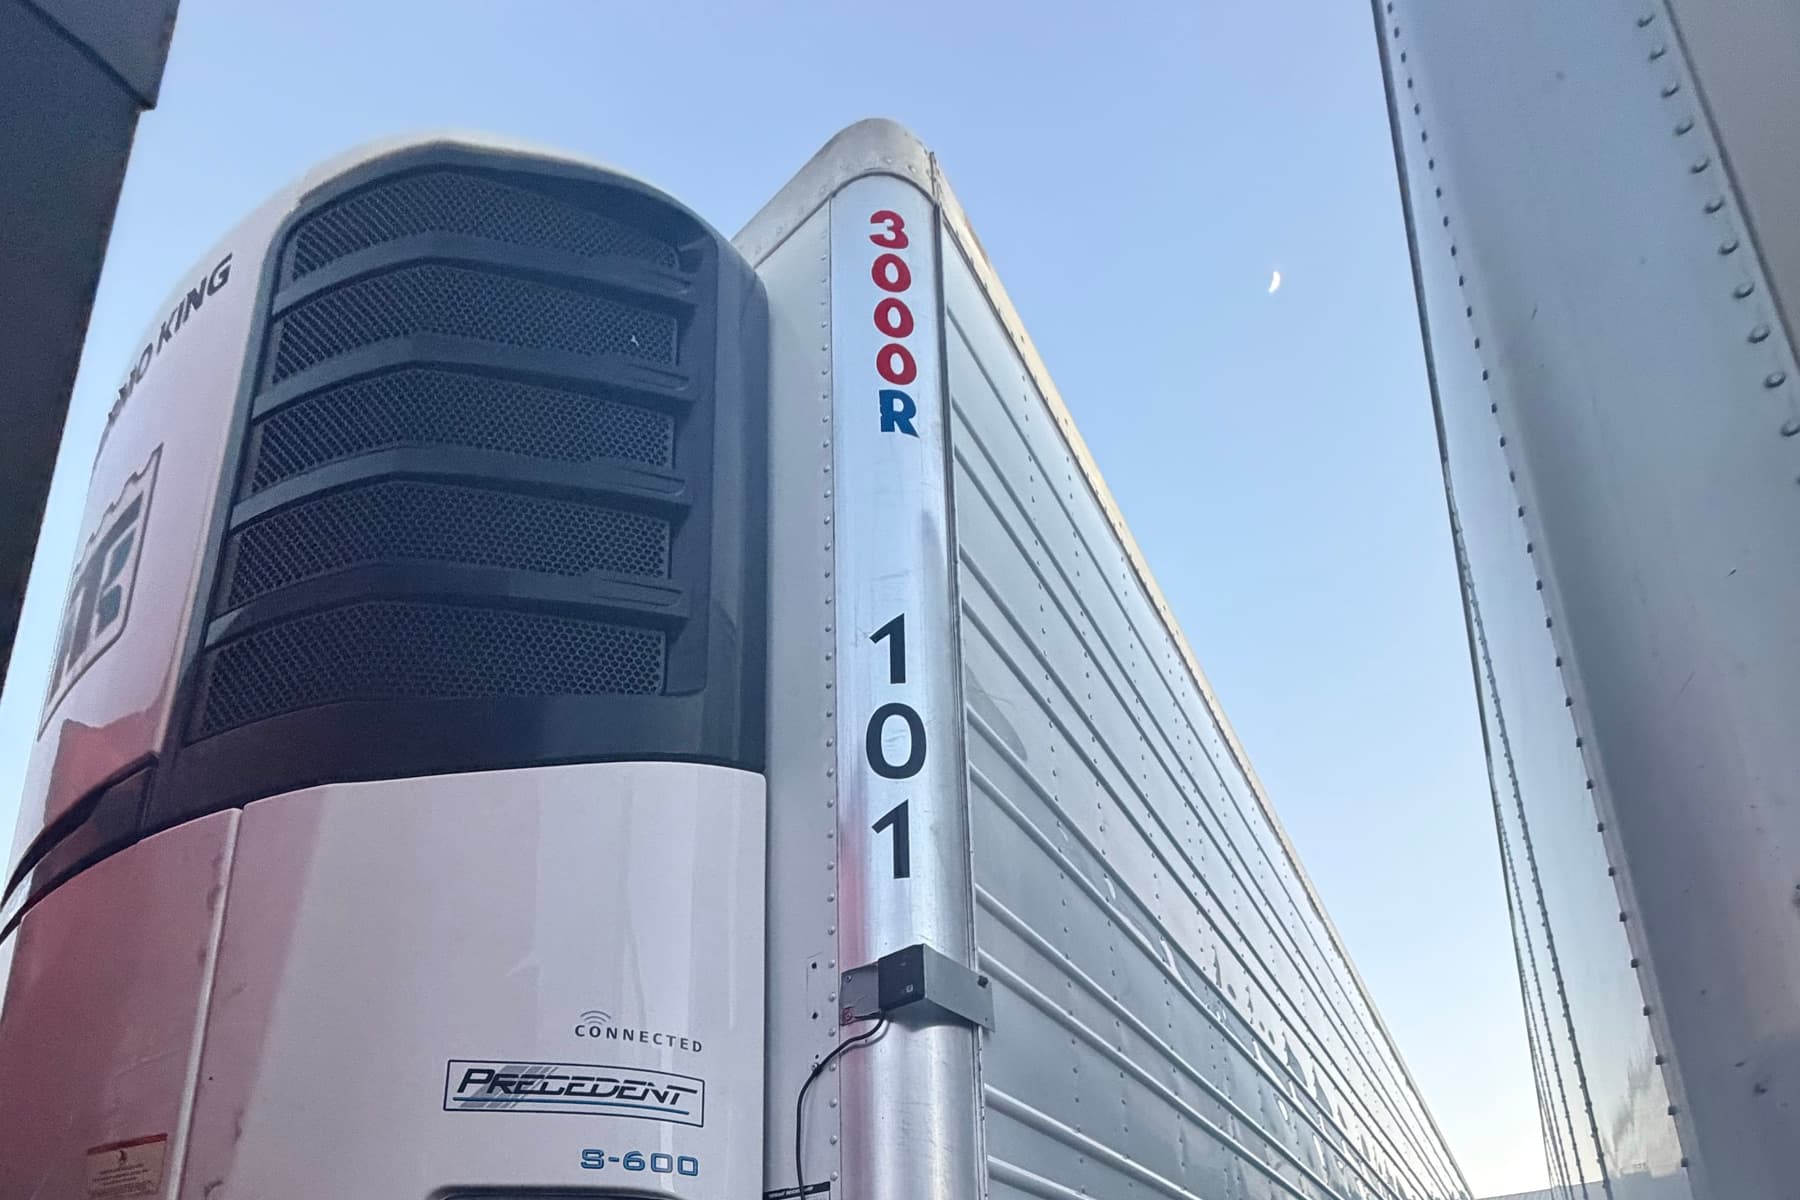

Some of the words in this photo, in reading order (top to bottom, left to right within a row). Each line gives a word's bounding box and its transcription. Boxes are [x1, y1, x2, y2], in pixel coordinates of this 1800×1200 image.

[156, 252, 233, 356] KING
[869, 209, 919, 438] 3000R
[865, 612, 927, 880] 101
[574, 1024, 703, 1053] CONNECTED
[456, 1067, 698, 1106] PRECEDENT
[580, 1148, 699, 1177] S-600
